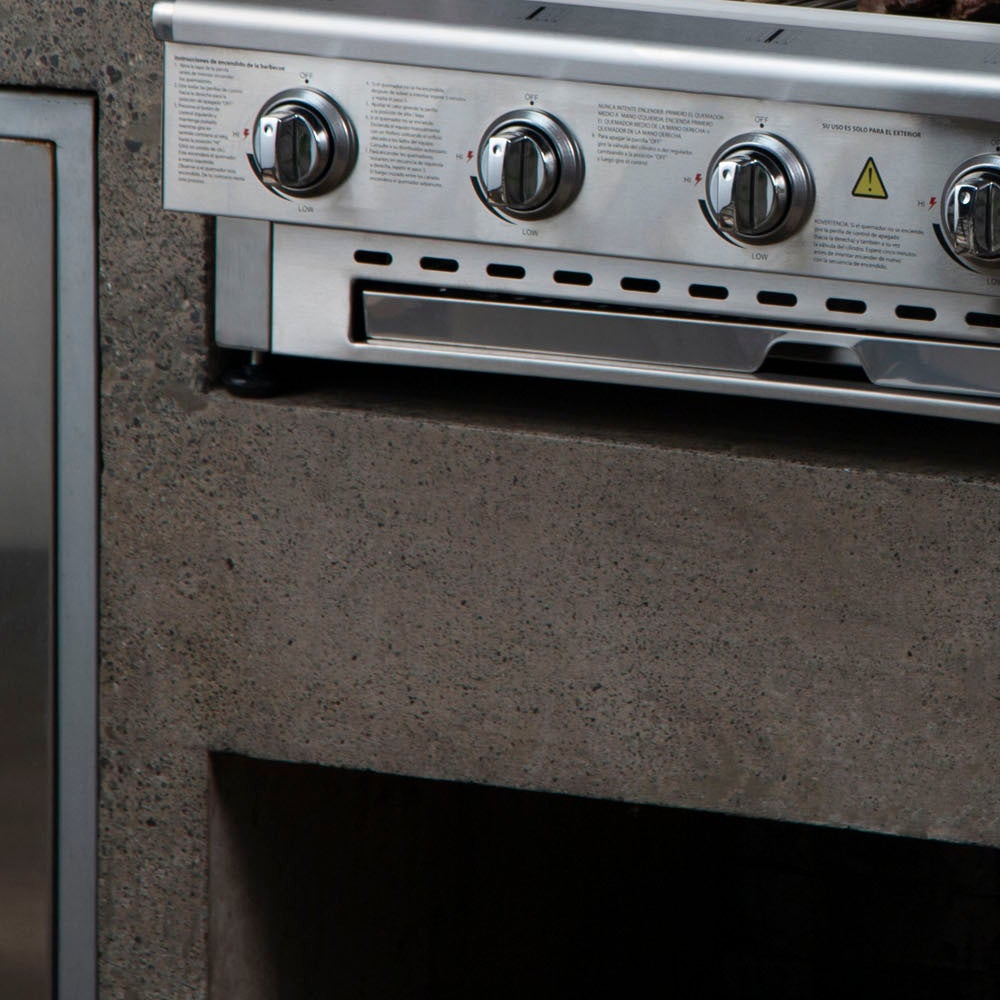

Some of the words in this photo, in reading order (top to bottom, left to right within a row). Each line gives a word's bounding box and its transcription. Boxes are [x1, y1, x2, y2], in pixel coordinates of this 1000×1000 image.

[525, 93, 538, 101] OFF
[831, 123, 844, 131] USO
[853, 125, 868, 133] SOLO
[869, 127, 884, 135] PARA
[885, 128, 892, 136] EL
[893, 129, 922, 138] EXTERIOR
[298, 204, 314, 212] LOW
[522, 229, 539, 237] LOW
[752, 253, 768, 261] LOW
